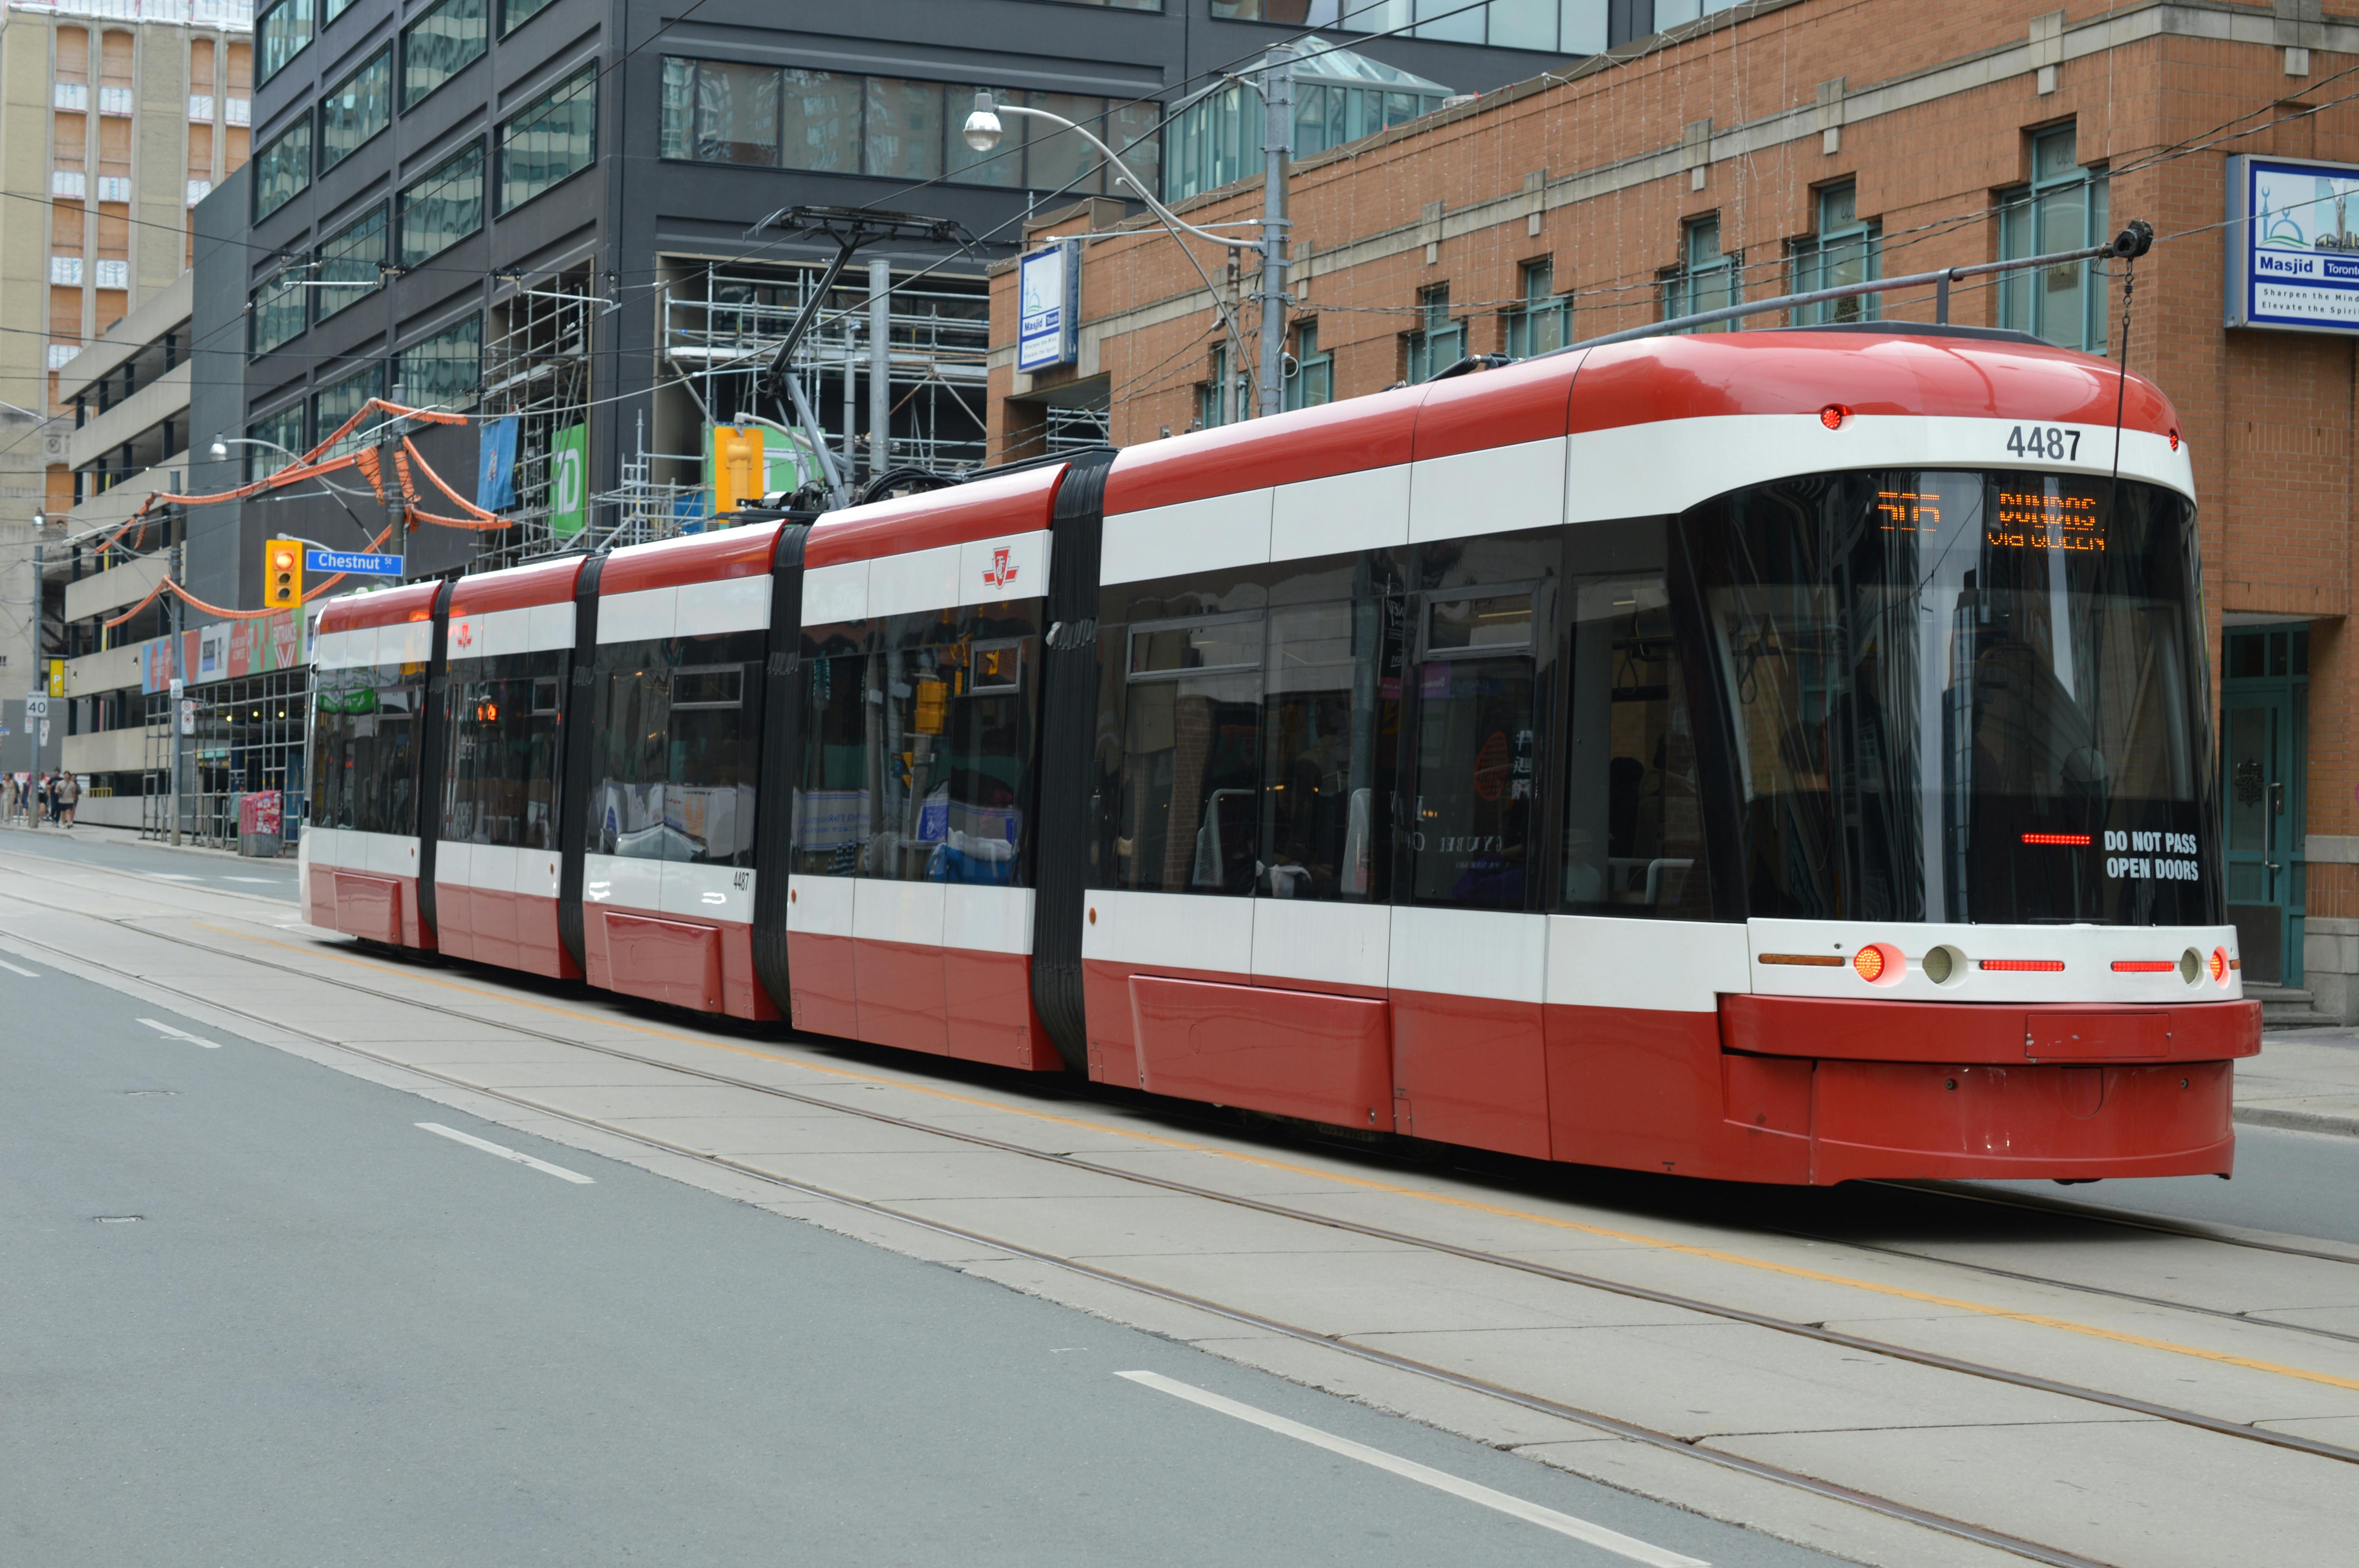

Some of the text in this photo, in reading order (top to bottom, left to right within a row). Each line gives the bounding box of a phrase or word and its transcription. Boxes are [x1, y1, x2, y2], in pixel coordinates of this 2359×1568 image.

[2260, 256, 2313, 274] Masjid
[2264, 289, 2307, 299] Sharpen
[2262, 301, 2302, 311] Elevate
[2330, 306, 2359, 316] Spiri
[1025, 314, 1058, 331] Masjid Toronto
[2006, 426, 2081, 461] 4487
[556, 448, 580, 515] TD
[1878, 492, 1940, 532] 505
[1999, 493, 2096, 526] DUNDAS
[318, 553, 380, 570] Chestnut
[54, 675, 61, 684] P
[29, 702, 45, 713] 40
[2104, 831, 2197, 855] DO NOT PASS
[2106, 857, 2199, 881] OPEN DOORS
[733, 871, 749, 891] 4487
